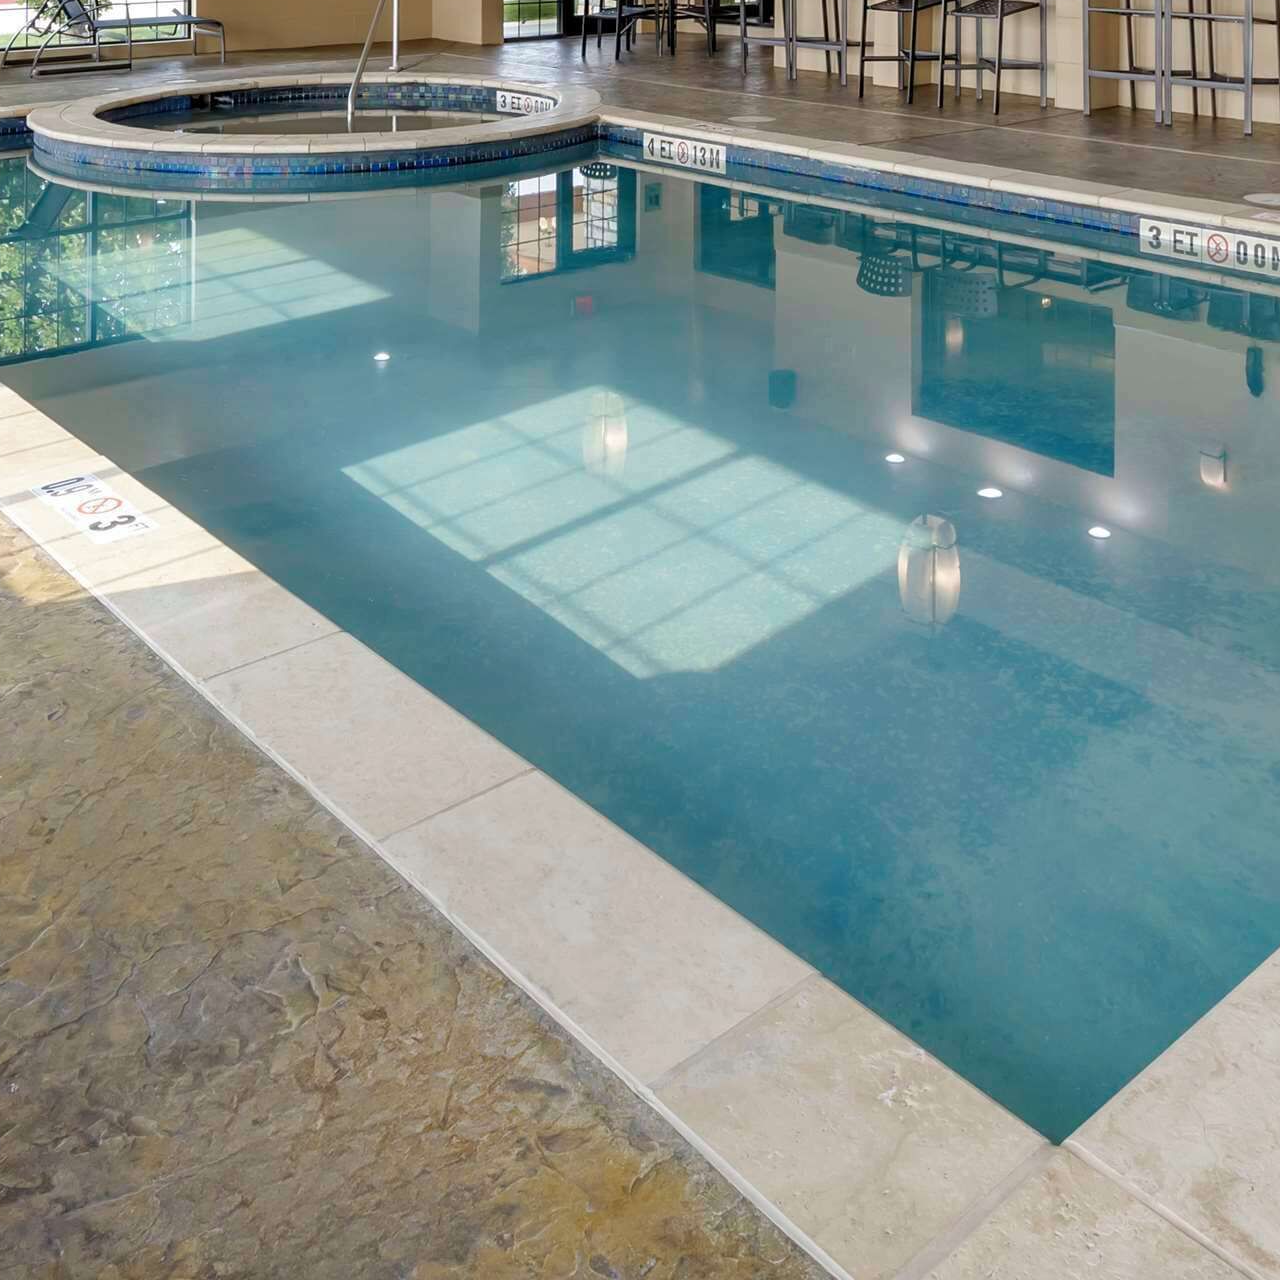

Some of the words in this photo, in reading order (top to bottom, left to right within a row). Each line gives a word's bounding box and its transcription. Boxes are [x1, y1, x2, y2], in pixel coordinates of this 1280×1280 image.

[500, 94, 507, 109] 3
[1147, 225, 1162, 250] 3
[89, 514, 137, 532] 3
